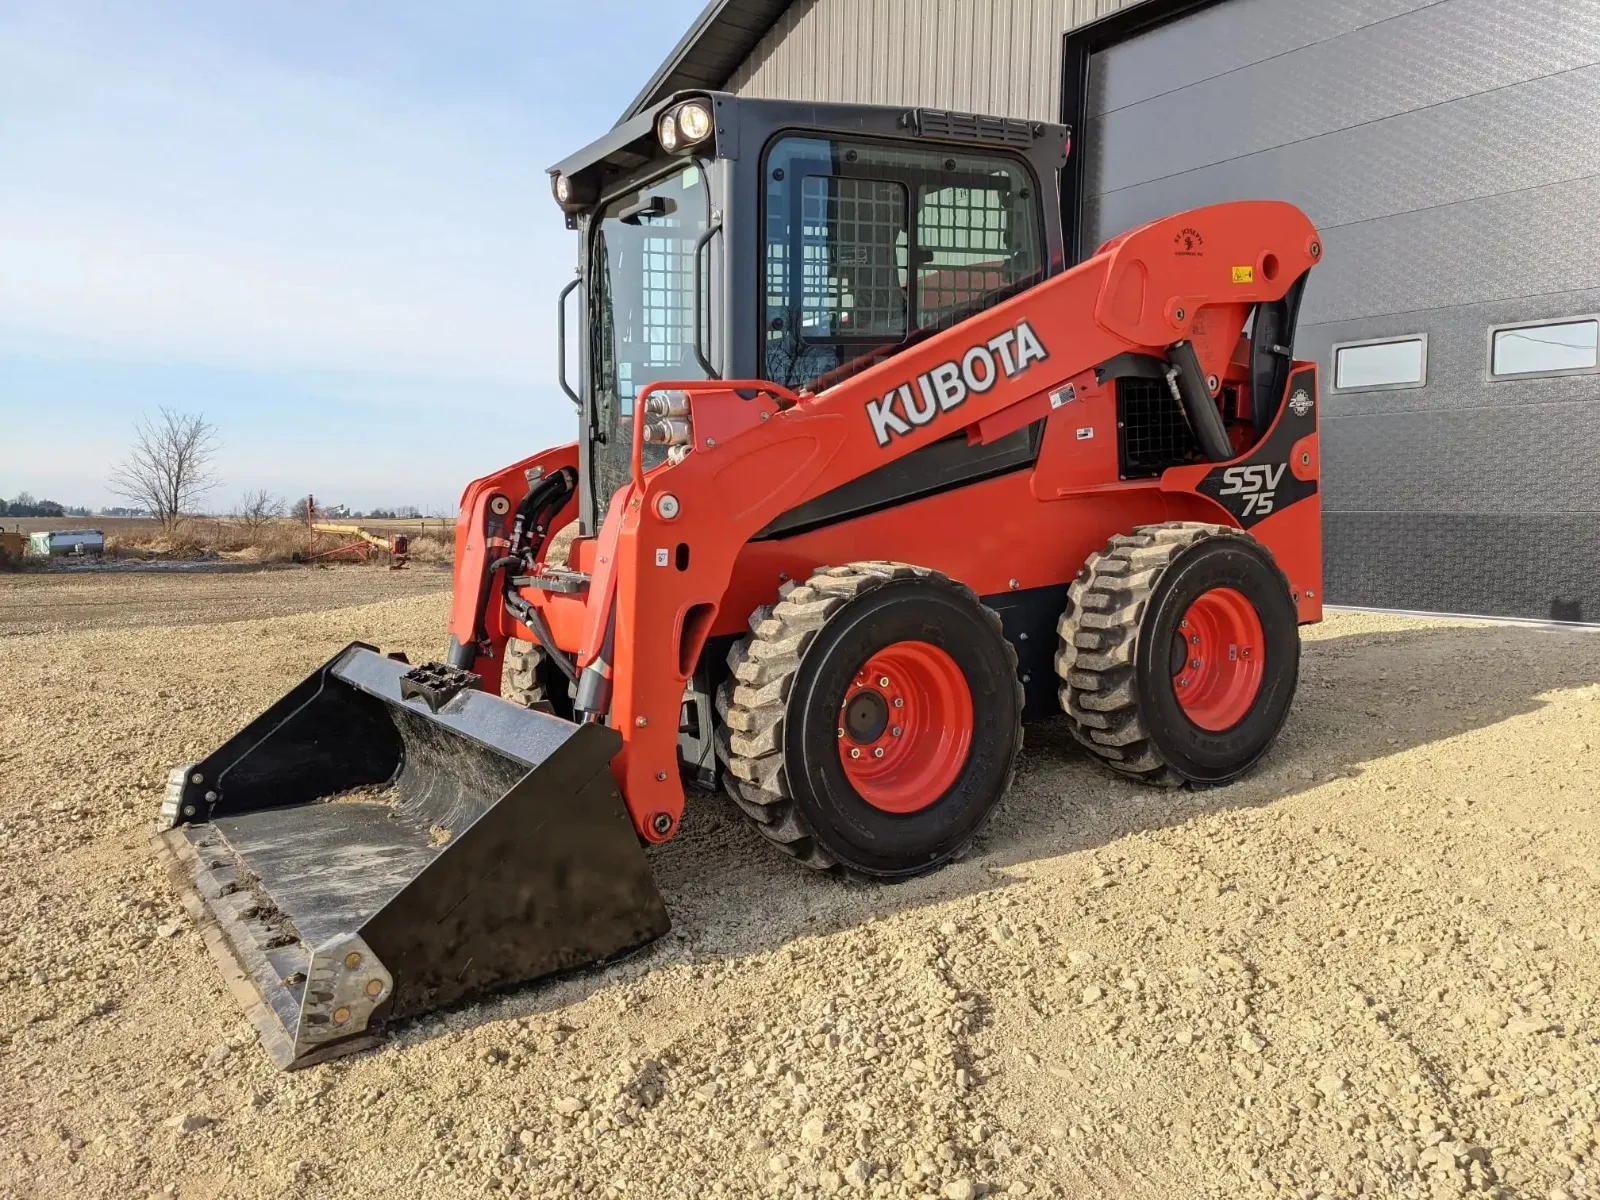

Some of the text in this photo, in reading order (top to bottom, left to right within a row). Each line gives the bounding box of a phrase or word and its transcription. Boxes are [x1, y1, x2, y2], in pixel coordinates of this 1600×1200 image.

[865, 321, 1048, 446] KUBOTA
[1220, 462, 1287, 495] SSV
[1241, 492, 1275, 516] 75
